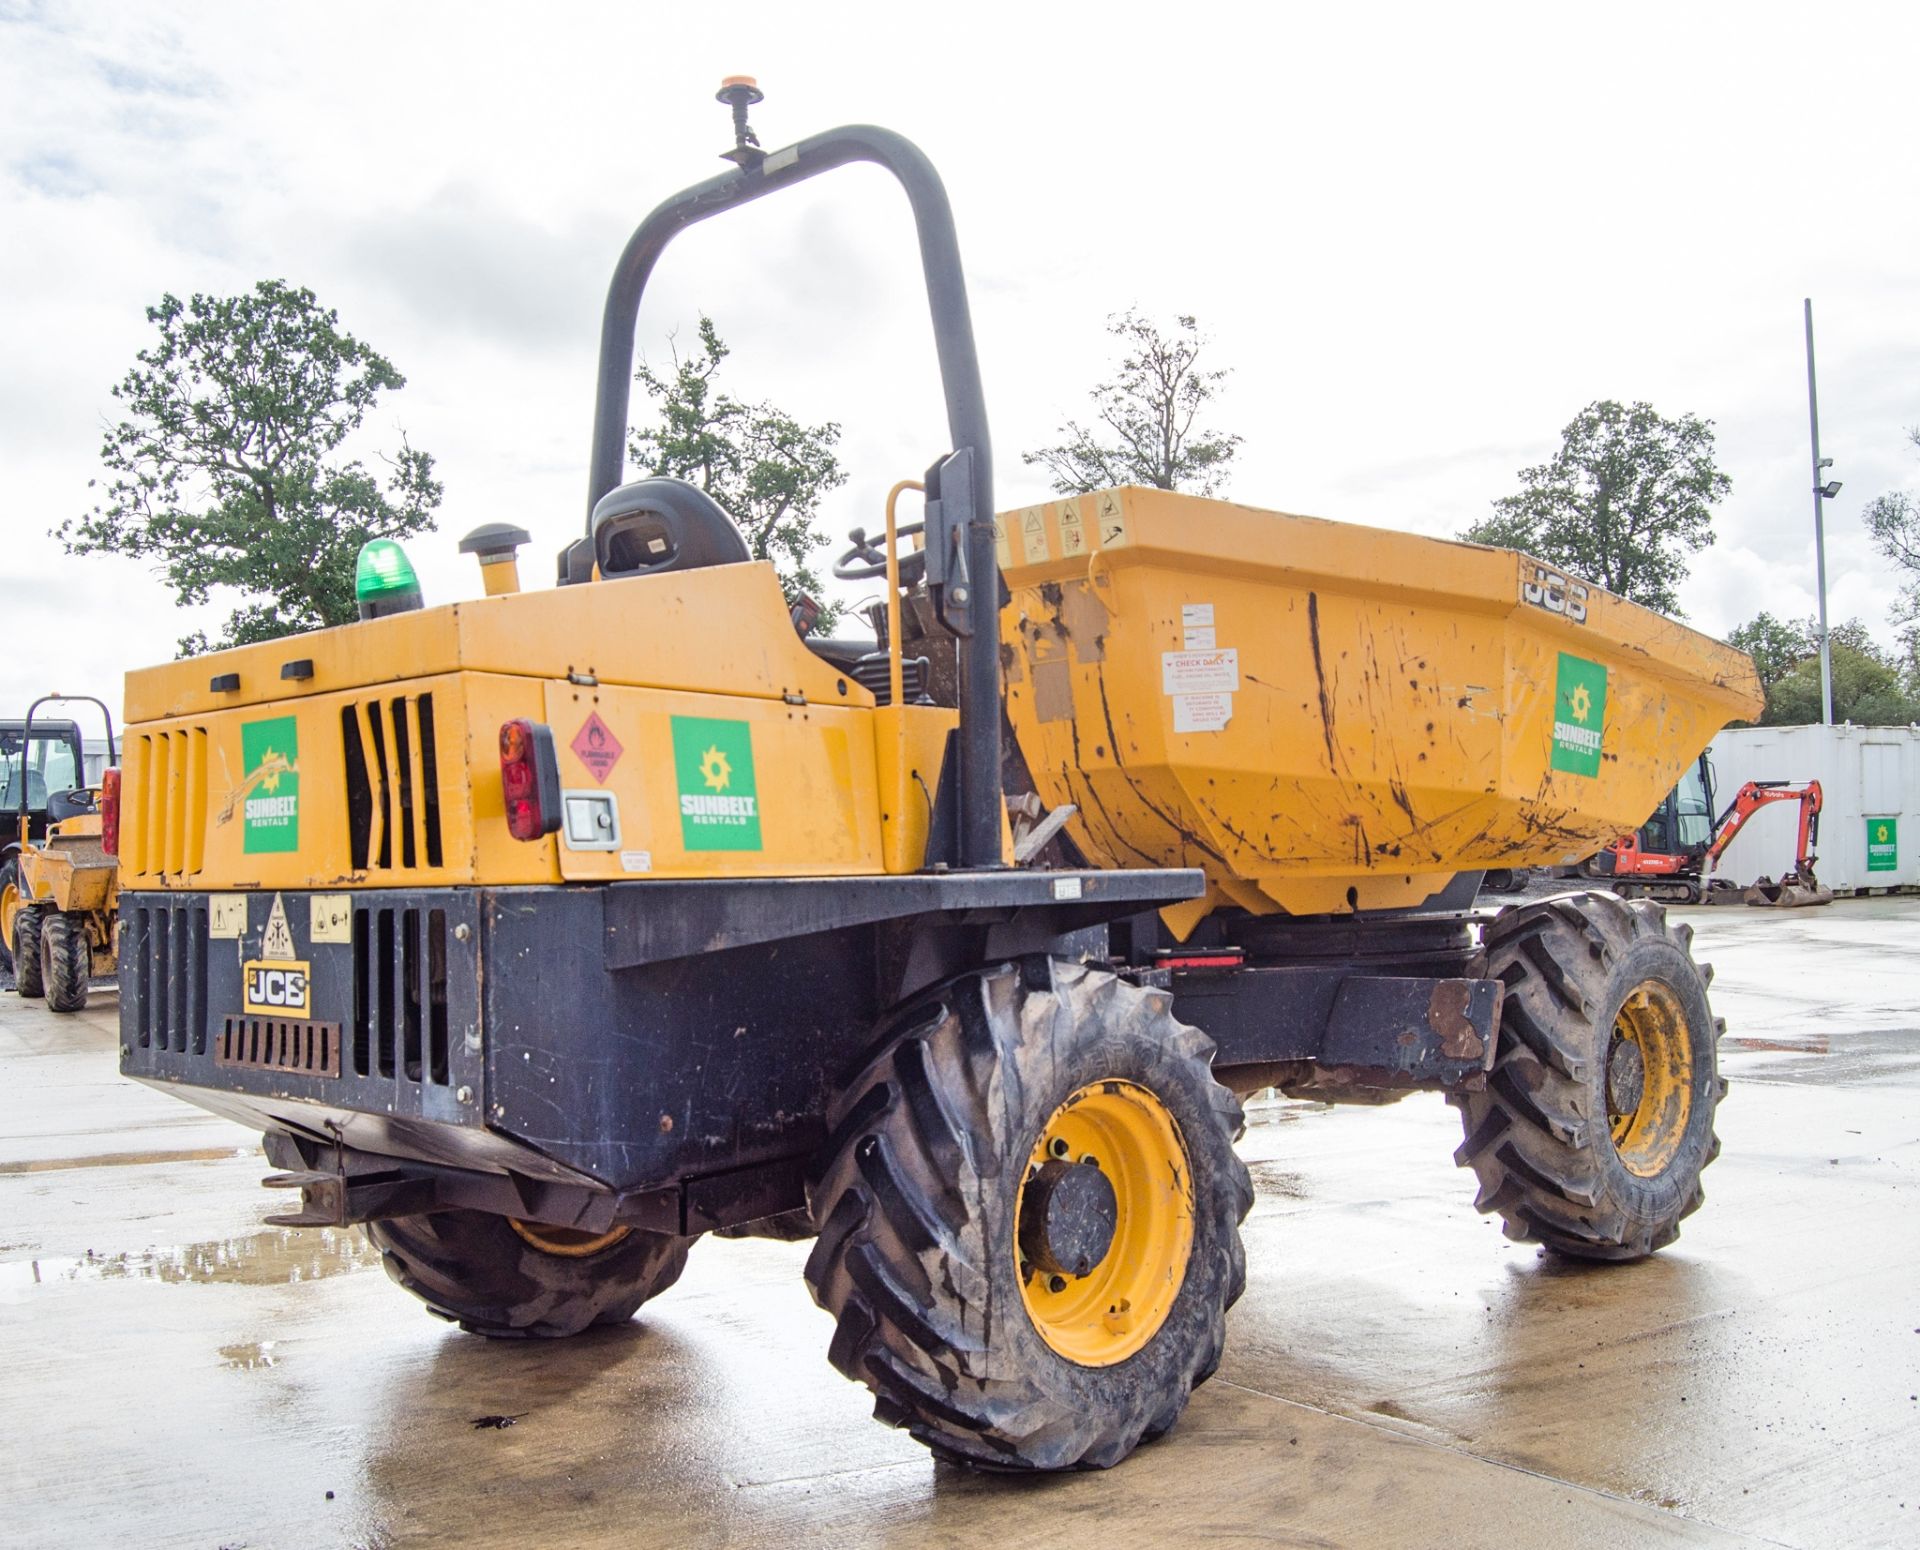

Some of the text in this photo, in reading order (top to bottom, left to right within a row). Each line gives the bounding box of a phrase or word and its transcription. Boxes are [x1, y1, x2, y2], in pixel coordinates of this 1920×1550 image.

[1523, 567, 1589, 623] JCB
[1175, 660, 1200, 668] CHECK
[1554, 721, 1601, 749] SUNBELT
[1559, 741, 1593, 755] RENTALS
[246, 796, 297, 819] SUNBELT
[680, 794, 756, 816] SUNBELT
[252, 817, 289, 828] RENTALS
[693, 815, 746, 825] RENTALS
[248, 970, 306, 1006] JCB
